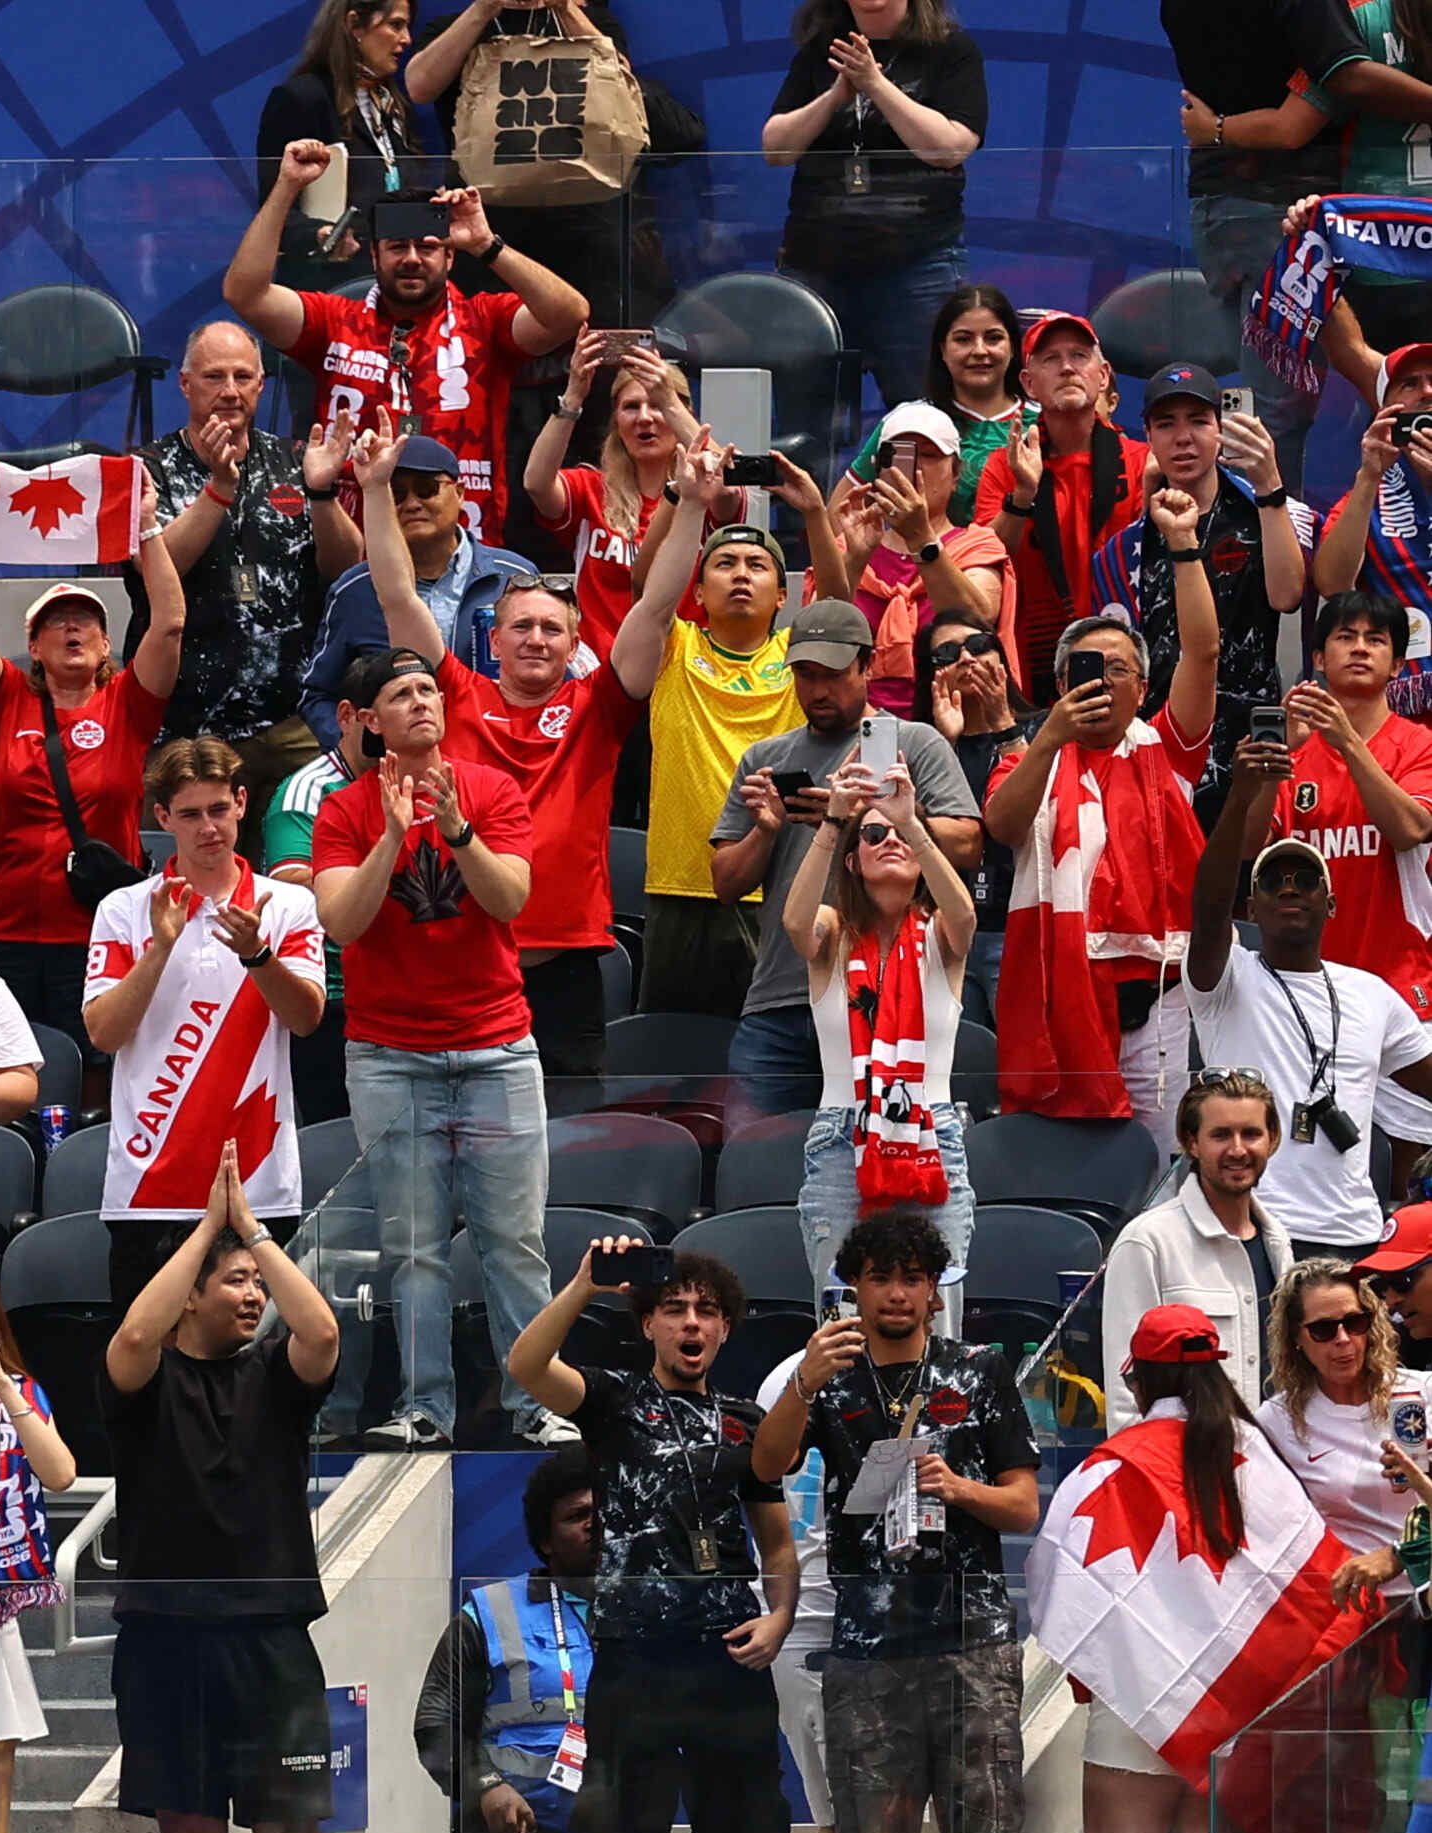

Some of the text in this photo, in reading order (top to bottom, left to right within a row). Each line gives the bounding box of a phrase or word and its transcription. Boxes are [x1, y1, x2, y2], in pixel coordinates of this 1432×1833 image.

[500, 59, 587, 96] WE
[496, 97, 586, 129] ARE
[494, 127, 583, 164] 26
[1325, 212, 1380, 244] FIFA
[324, 356, 386, 384] CANADA
[1290, 824, 1381, 859] CANAD
[125, 998, 221, 1159] CANADA
